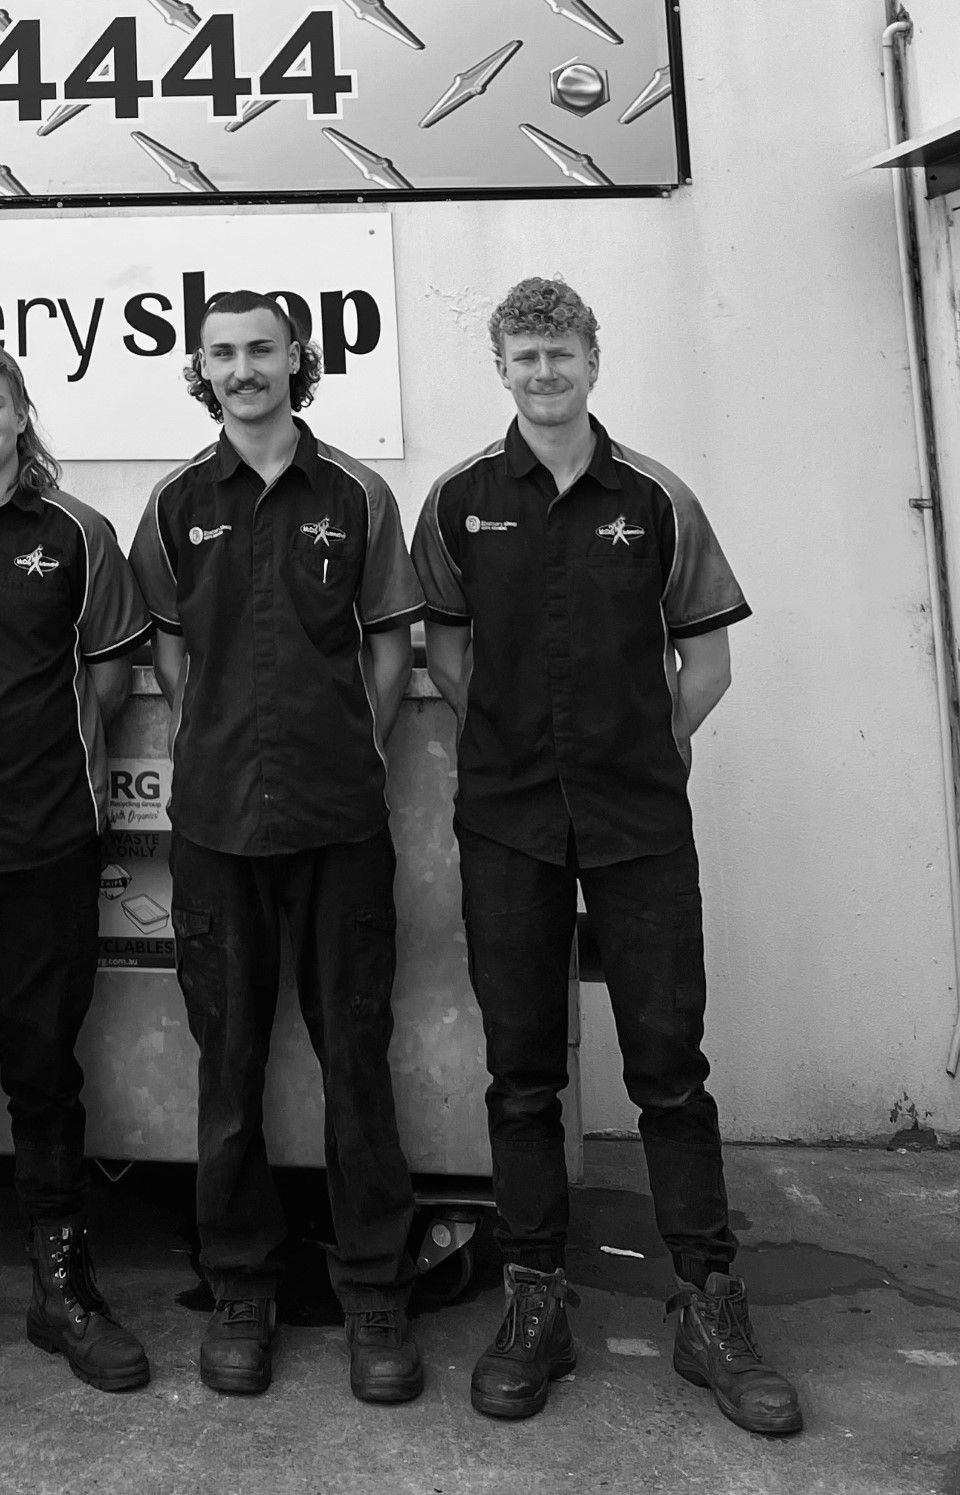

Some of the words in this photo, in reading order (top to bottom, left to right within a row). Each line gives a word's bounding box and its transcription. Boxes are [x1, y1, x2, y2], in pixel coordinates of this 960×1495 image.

[107, 770, 161, 800] RG
[109, 832, 160, 845] WASTE
[116, 845, 157, 858] ONLY
